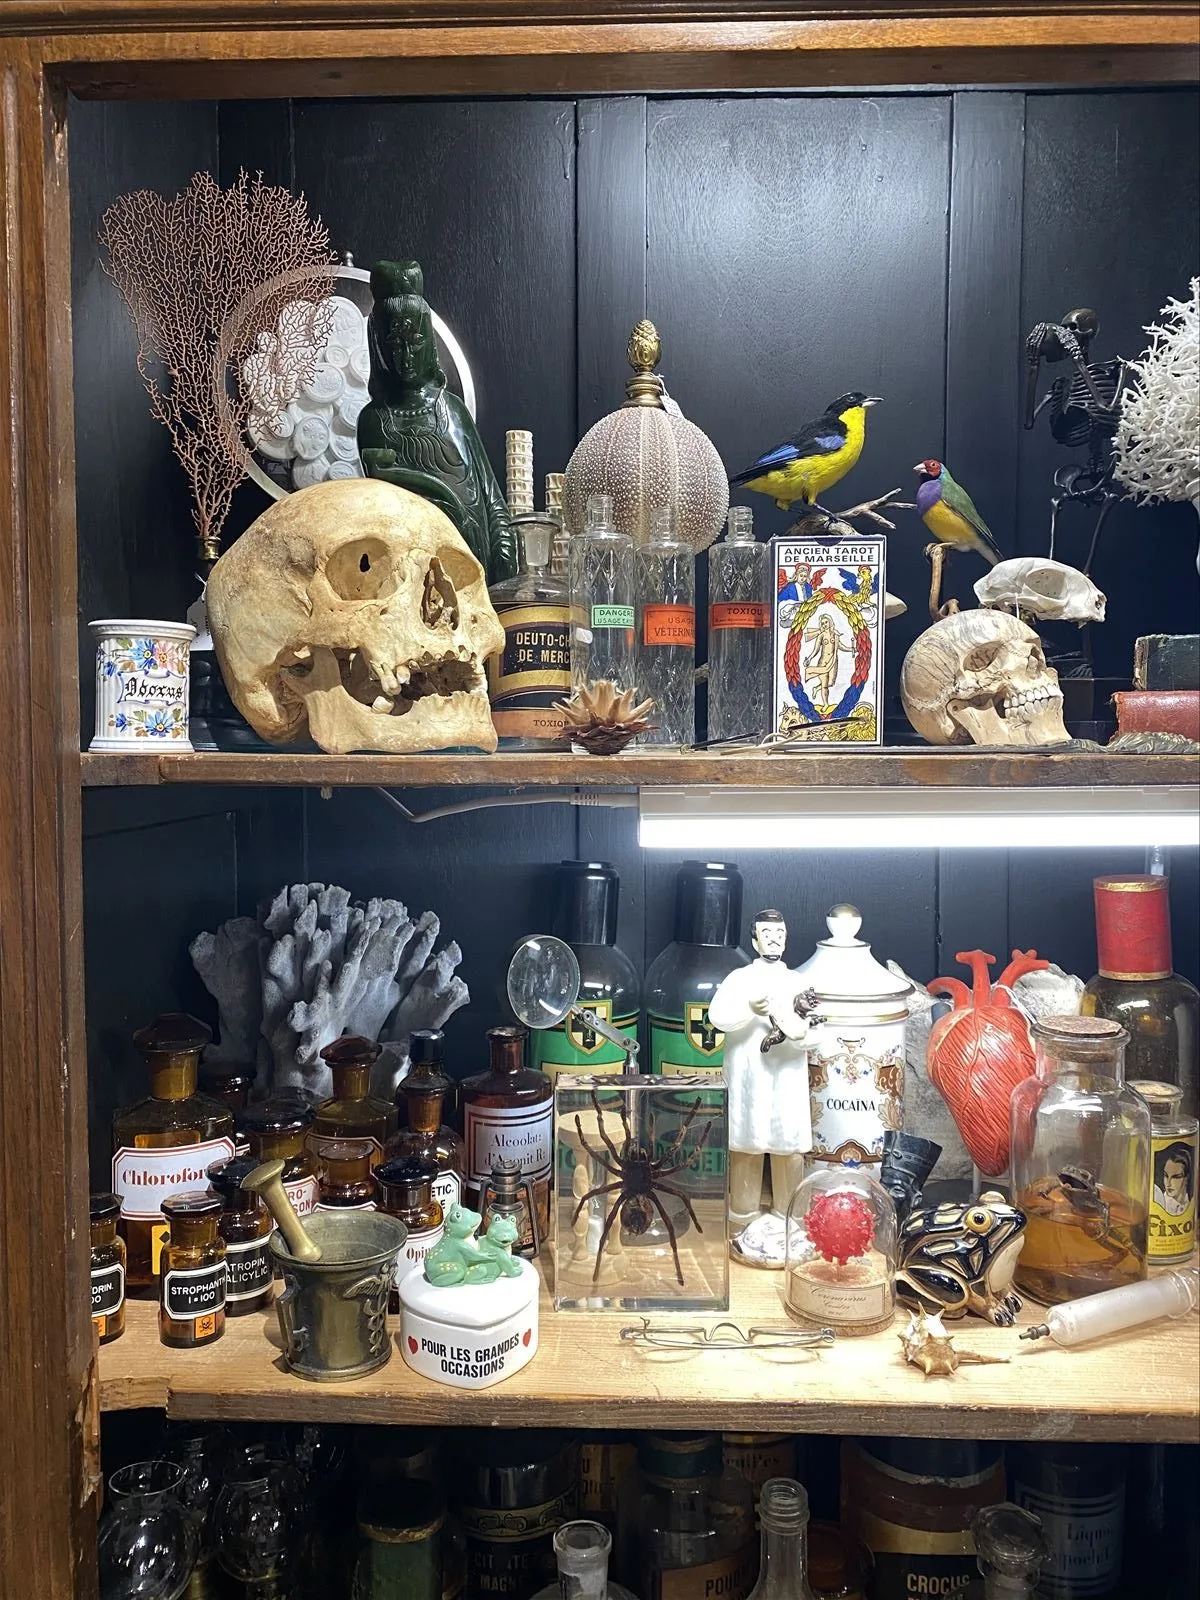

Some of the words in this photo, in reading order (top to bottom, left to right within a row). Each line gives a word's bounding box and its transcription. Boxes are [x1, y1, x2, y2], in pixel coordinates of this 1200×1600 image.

[784, 547, 830, 555] ANCIEN
[834, 547, 875, 555] TAROT
[784, 555, 800, 563] DE
[804, 555, 874, 563] MARSEILLE
[518, 649, 534, 662] DE
[541, 649, 570, 664] MERC
[421, 1337, 447, 1358] POUR
[450, 1346, 471, 1363] LES
[475, 1333, 520, 1363] GRANDES
[440, 1356, 505, 1378] OCCASIONS
